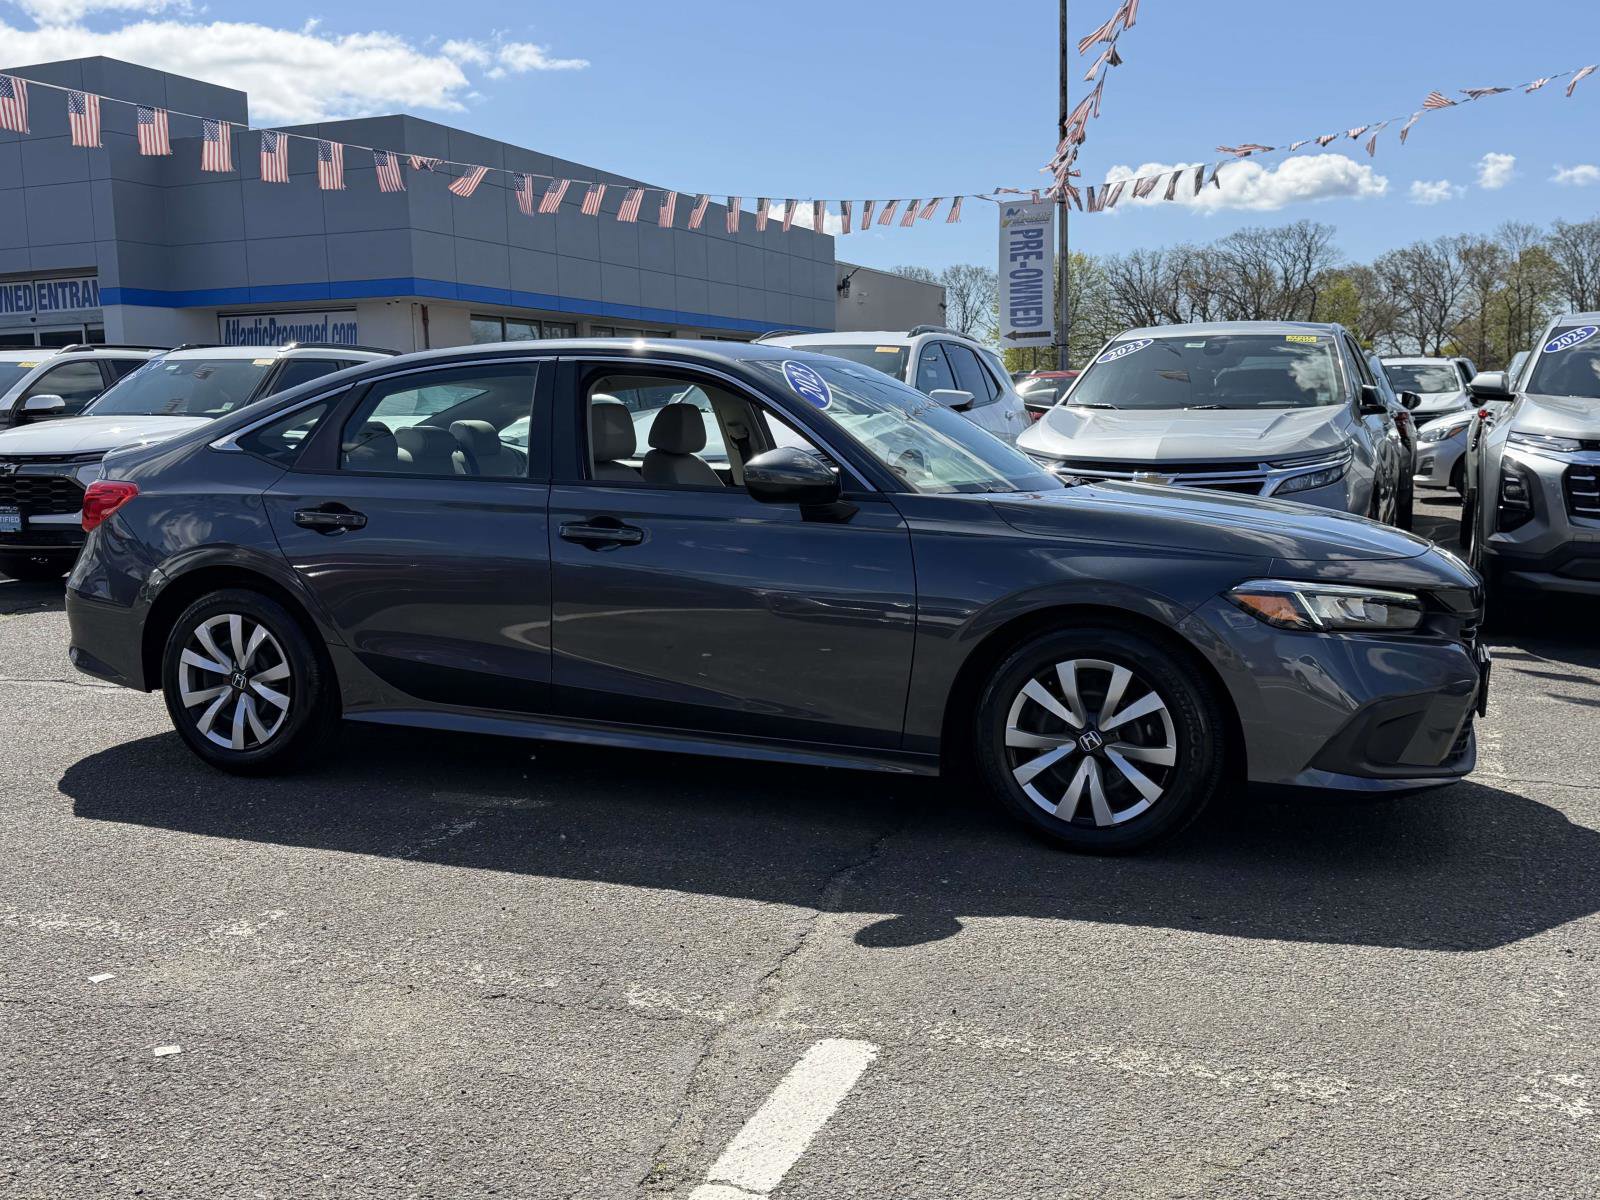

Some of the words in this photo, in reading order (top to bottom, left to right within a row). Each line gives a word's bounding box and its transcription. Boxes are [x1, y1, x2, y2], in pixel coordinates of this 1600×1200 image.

[1009, 228, 1044, 328] PRE-OWNED
[0, 284, 34, 313] NED
[224, 314, 358, 346] AtlanticPreownedcom
[1551, 329, 1588, 351] 2025
[1108, 340, 1145, 361] 2023
[786, 364, 827, 403] 2023
